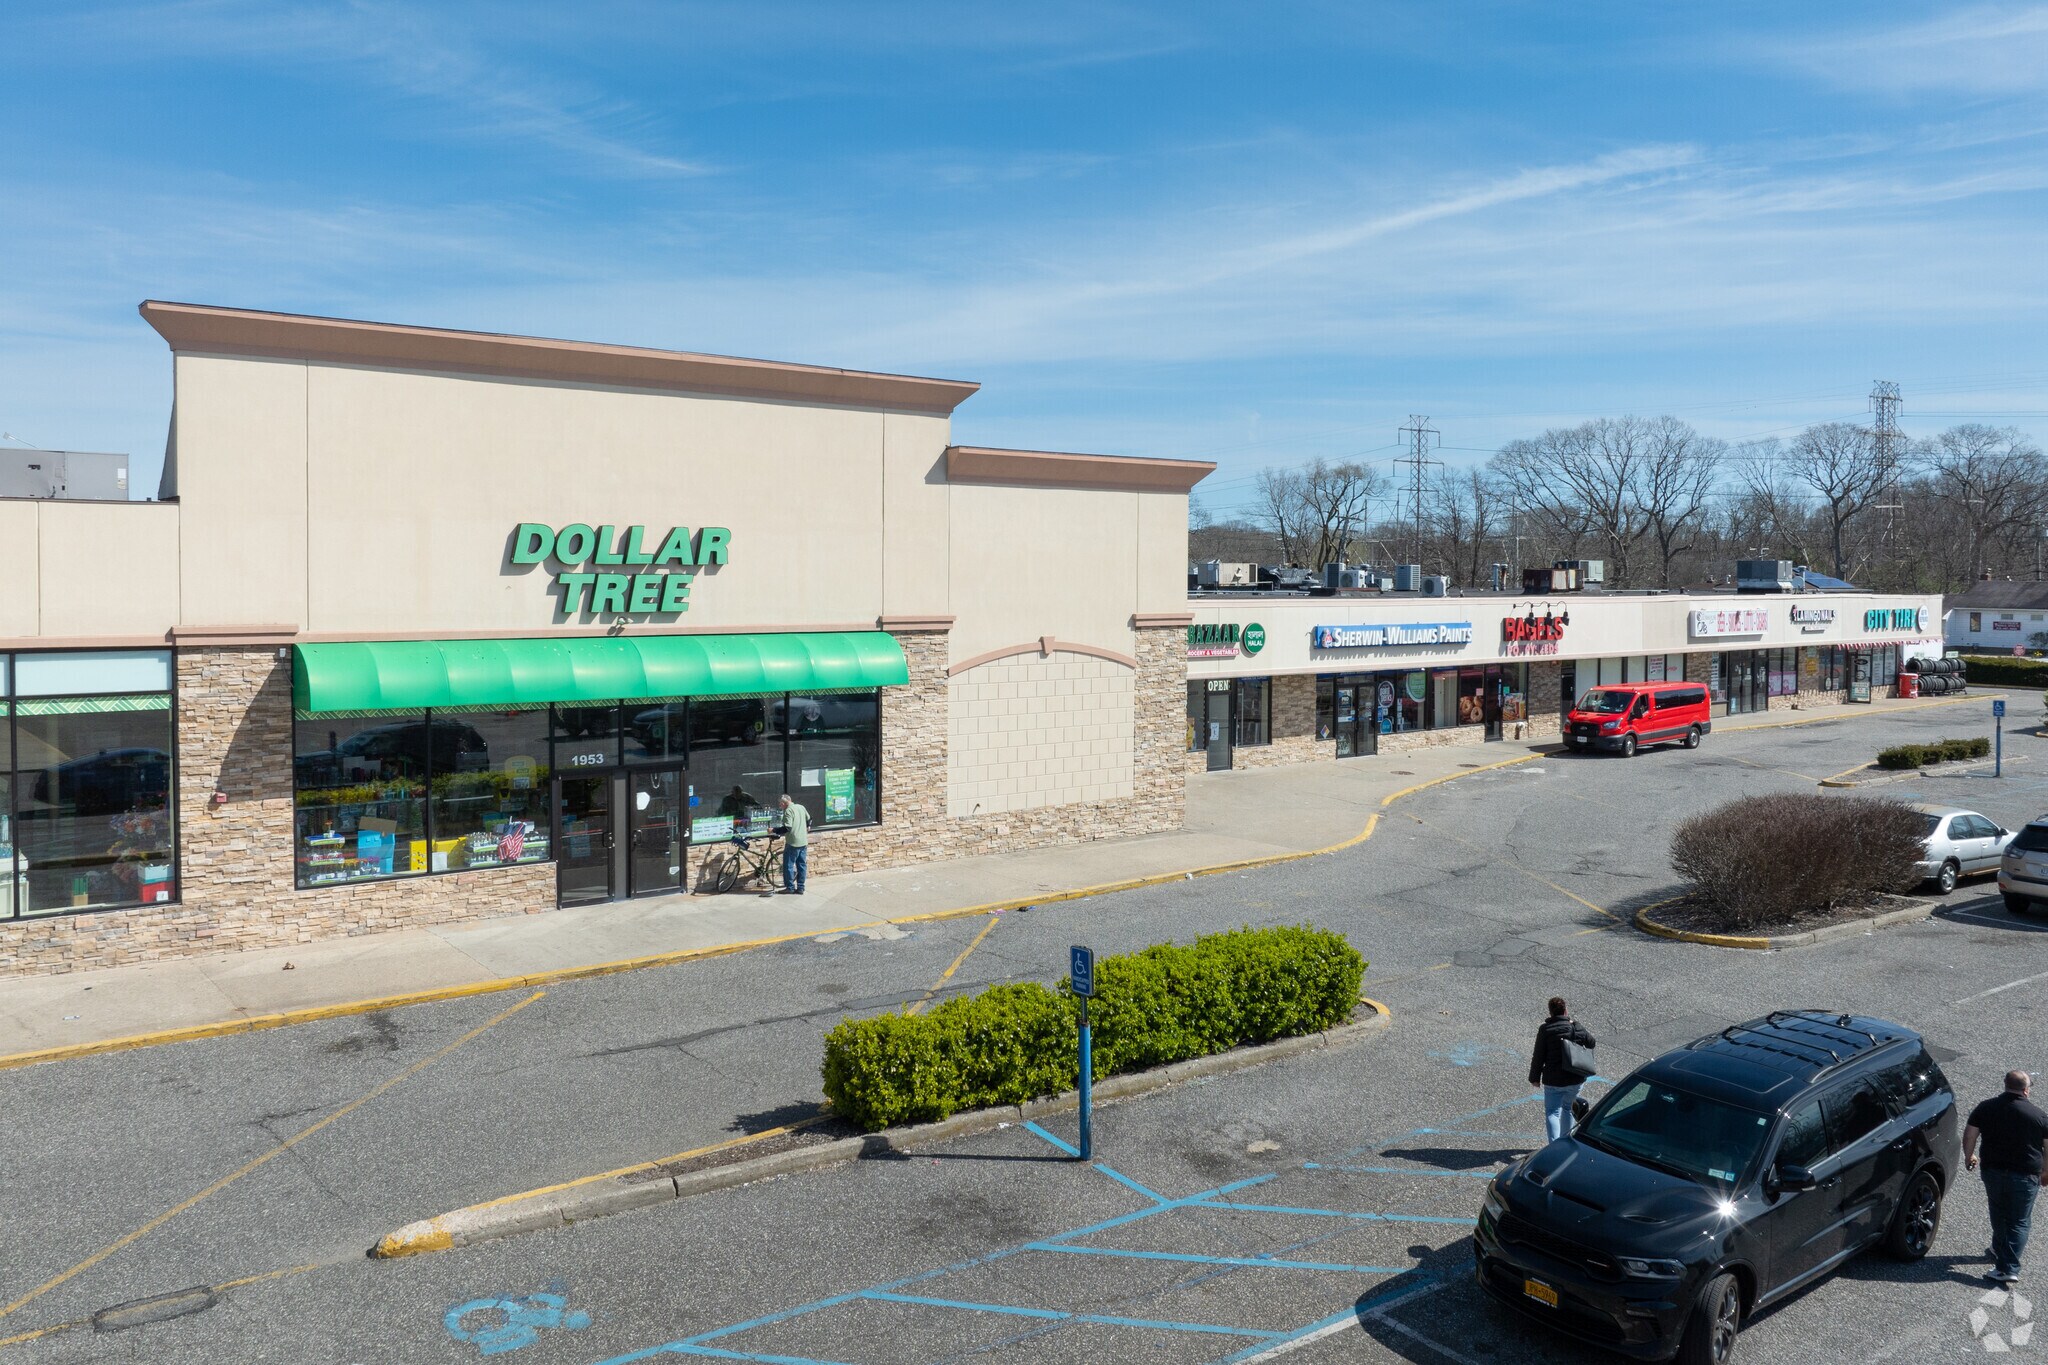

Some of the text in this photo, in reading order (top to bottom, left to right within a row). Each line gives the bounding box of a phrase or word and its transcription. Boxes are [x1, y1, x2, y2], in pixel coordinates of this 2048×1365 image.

[511, 522, 732, 566] DOLLAR
[557, 573, 694, 613] TREE
[1504, 616, 1563, 641] BAGELS
[1867, 609, 1890, 629] CITY
[1895, 608, 1916, 628] TIRE
[1187, 624, 1240, 644] BAZAAR
[1333, 625, 1472, 647] SHERWIN-WILLIAMS PAINTS
[1208, 680, 1229, 691] OPEN
[571, 753, 604, 766] 1953
